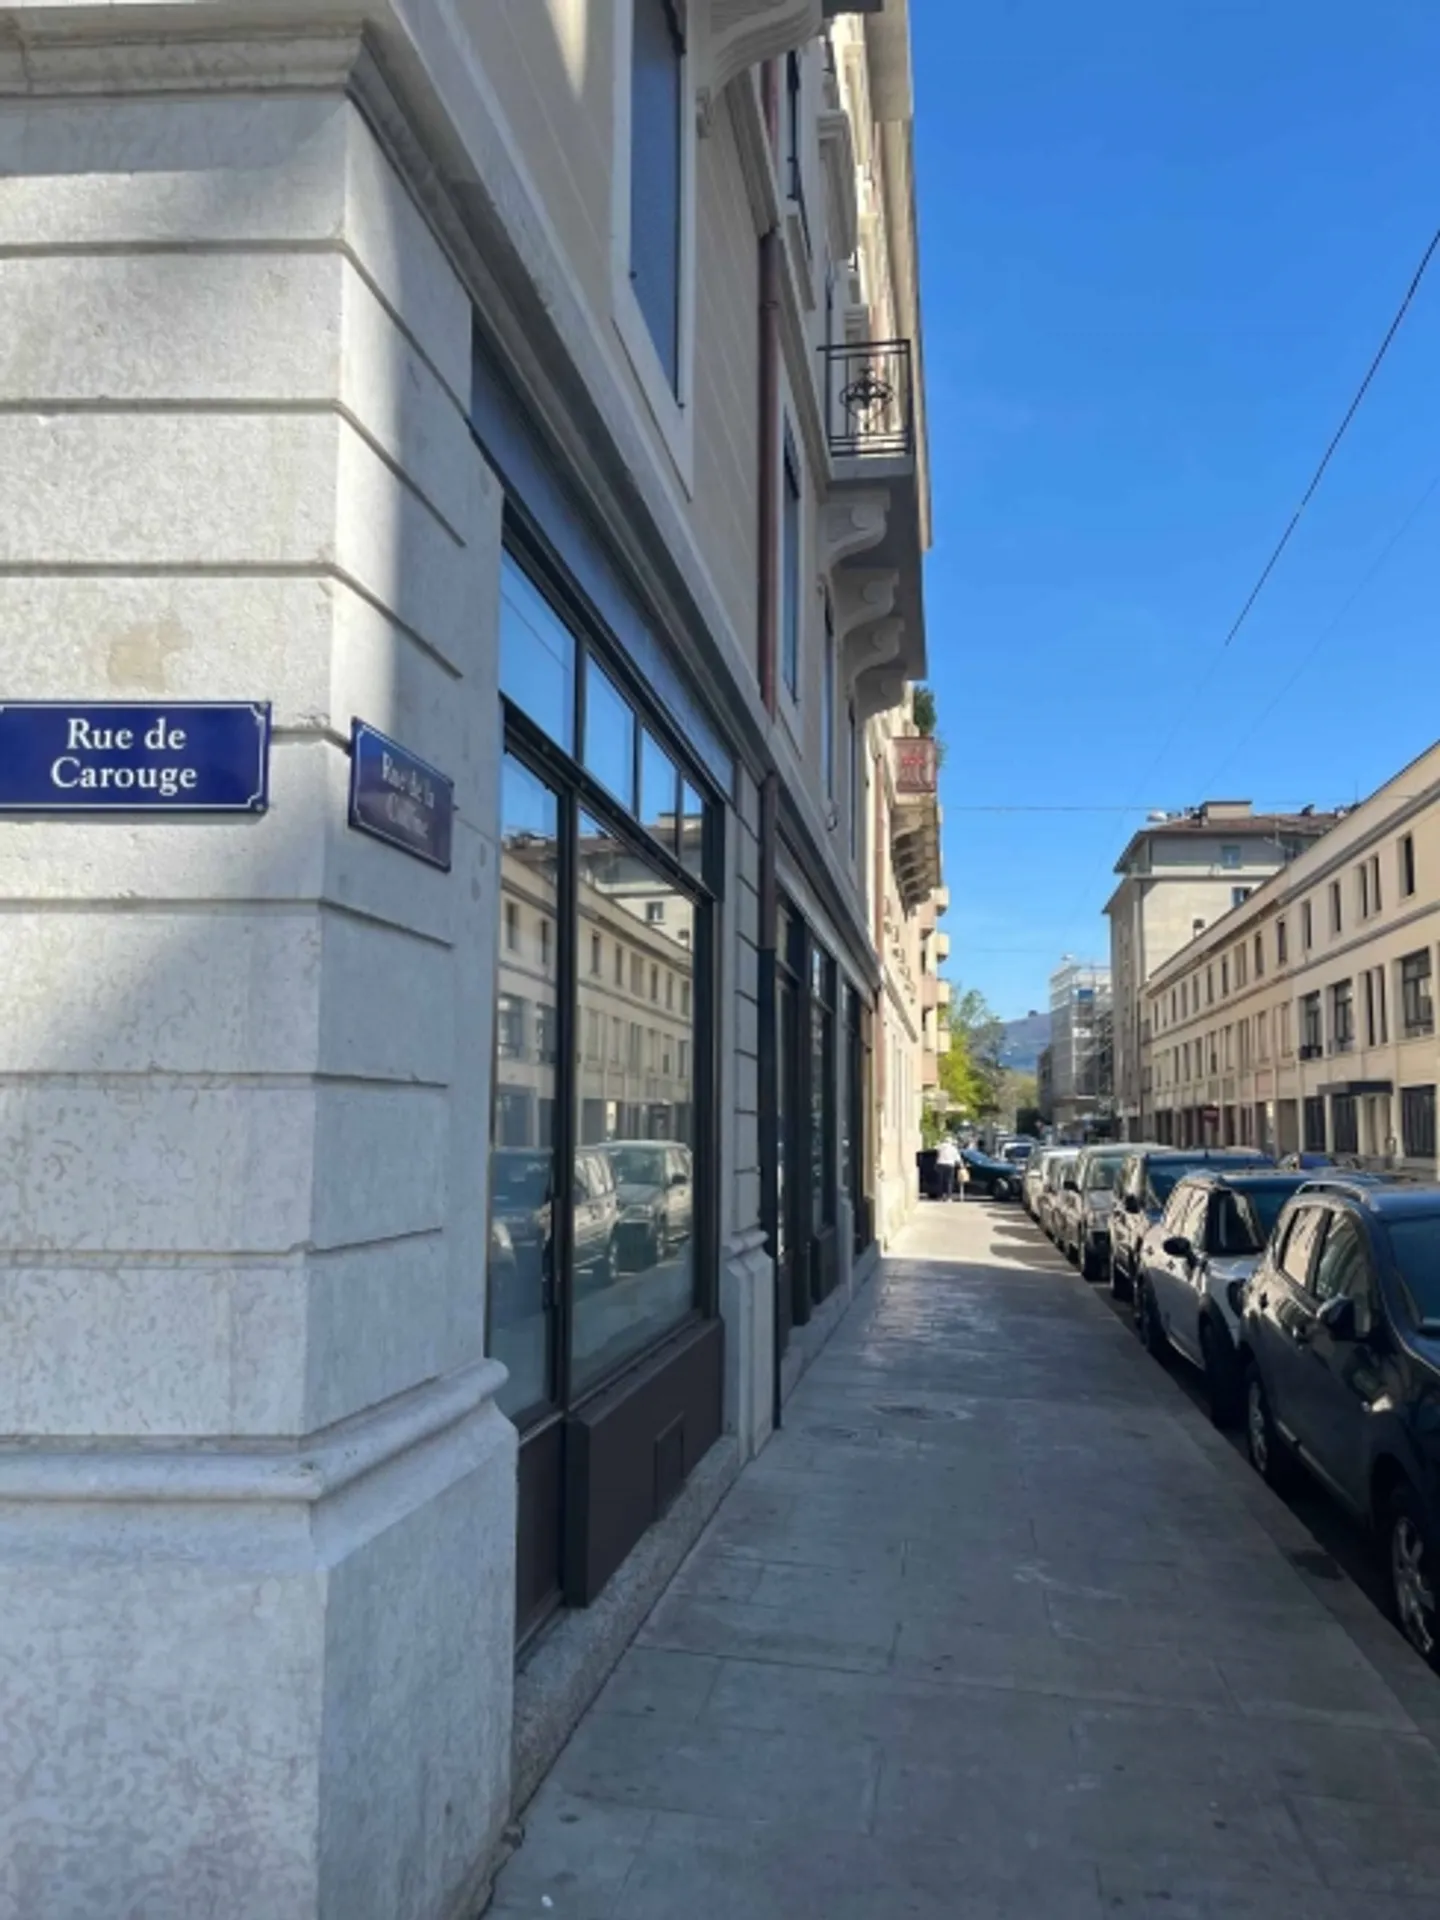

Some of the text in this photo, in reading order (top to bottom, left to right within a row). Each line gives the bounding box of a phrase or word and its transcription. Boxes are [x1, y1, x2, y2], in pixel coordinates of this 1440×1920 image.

[67, 715, 187, 751] Rue de
[50, 756, 198, 797] Carouge
